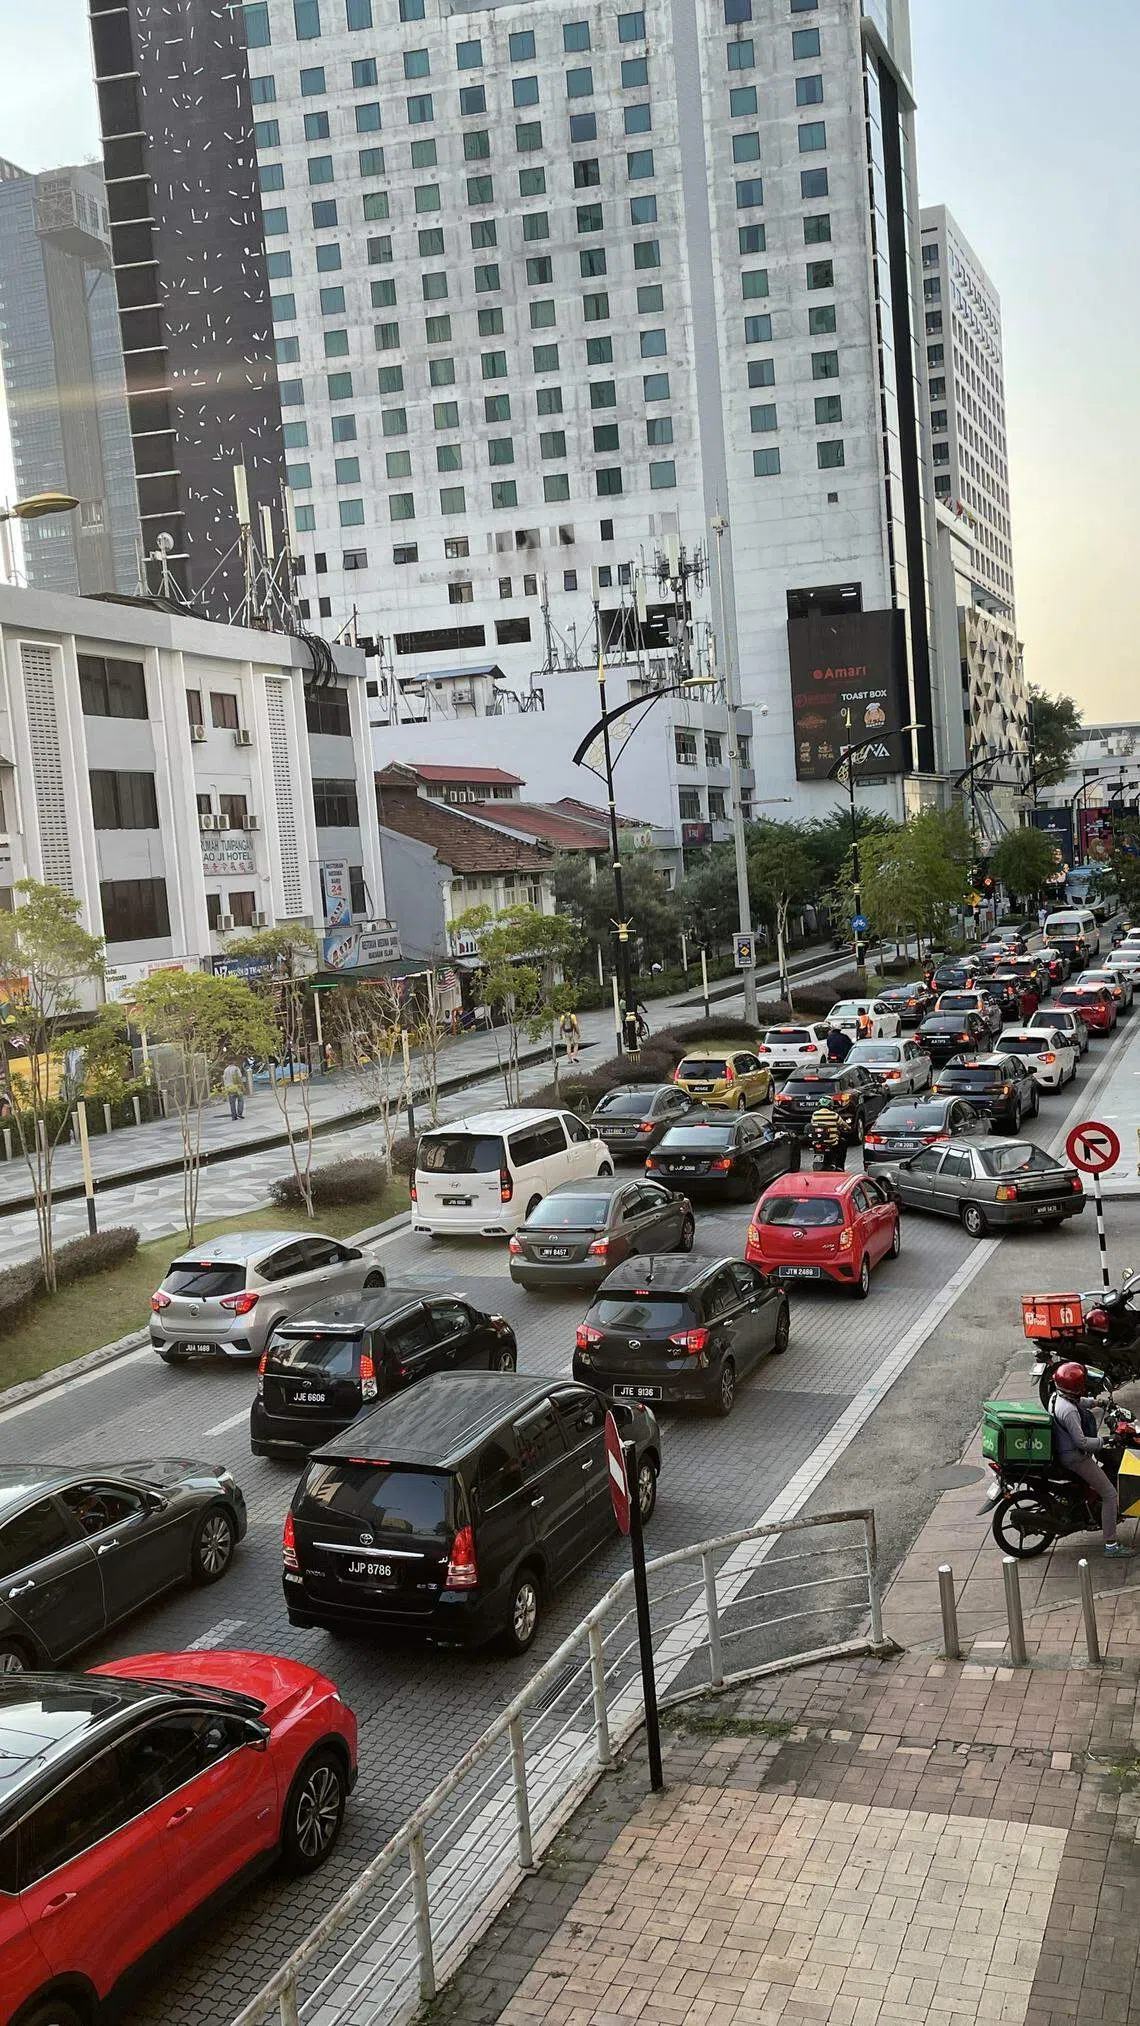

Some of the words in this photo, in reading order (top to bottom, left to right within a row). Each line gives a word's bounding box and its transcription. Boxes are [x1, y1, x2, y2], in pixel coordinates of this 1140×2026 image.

[824, 666, 867, 680] Amari
[841, 692, 868, 701] TOAST
[869, 689, 887, 698] BOX
[226, 852, 253, 861] HOTEL
[331, 885, 342, 893] 24
[620, 1387, 634, 1396] JTE
[293, 1392, 307, 1401] JJE
[307, 1393, 326, 1402] 6606
[348, 1562, 366, 1574] JJP
[367, 1563, 392, 1577] 8786
